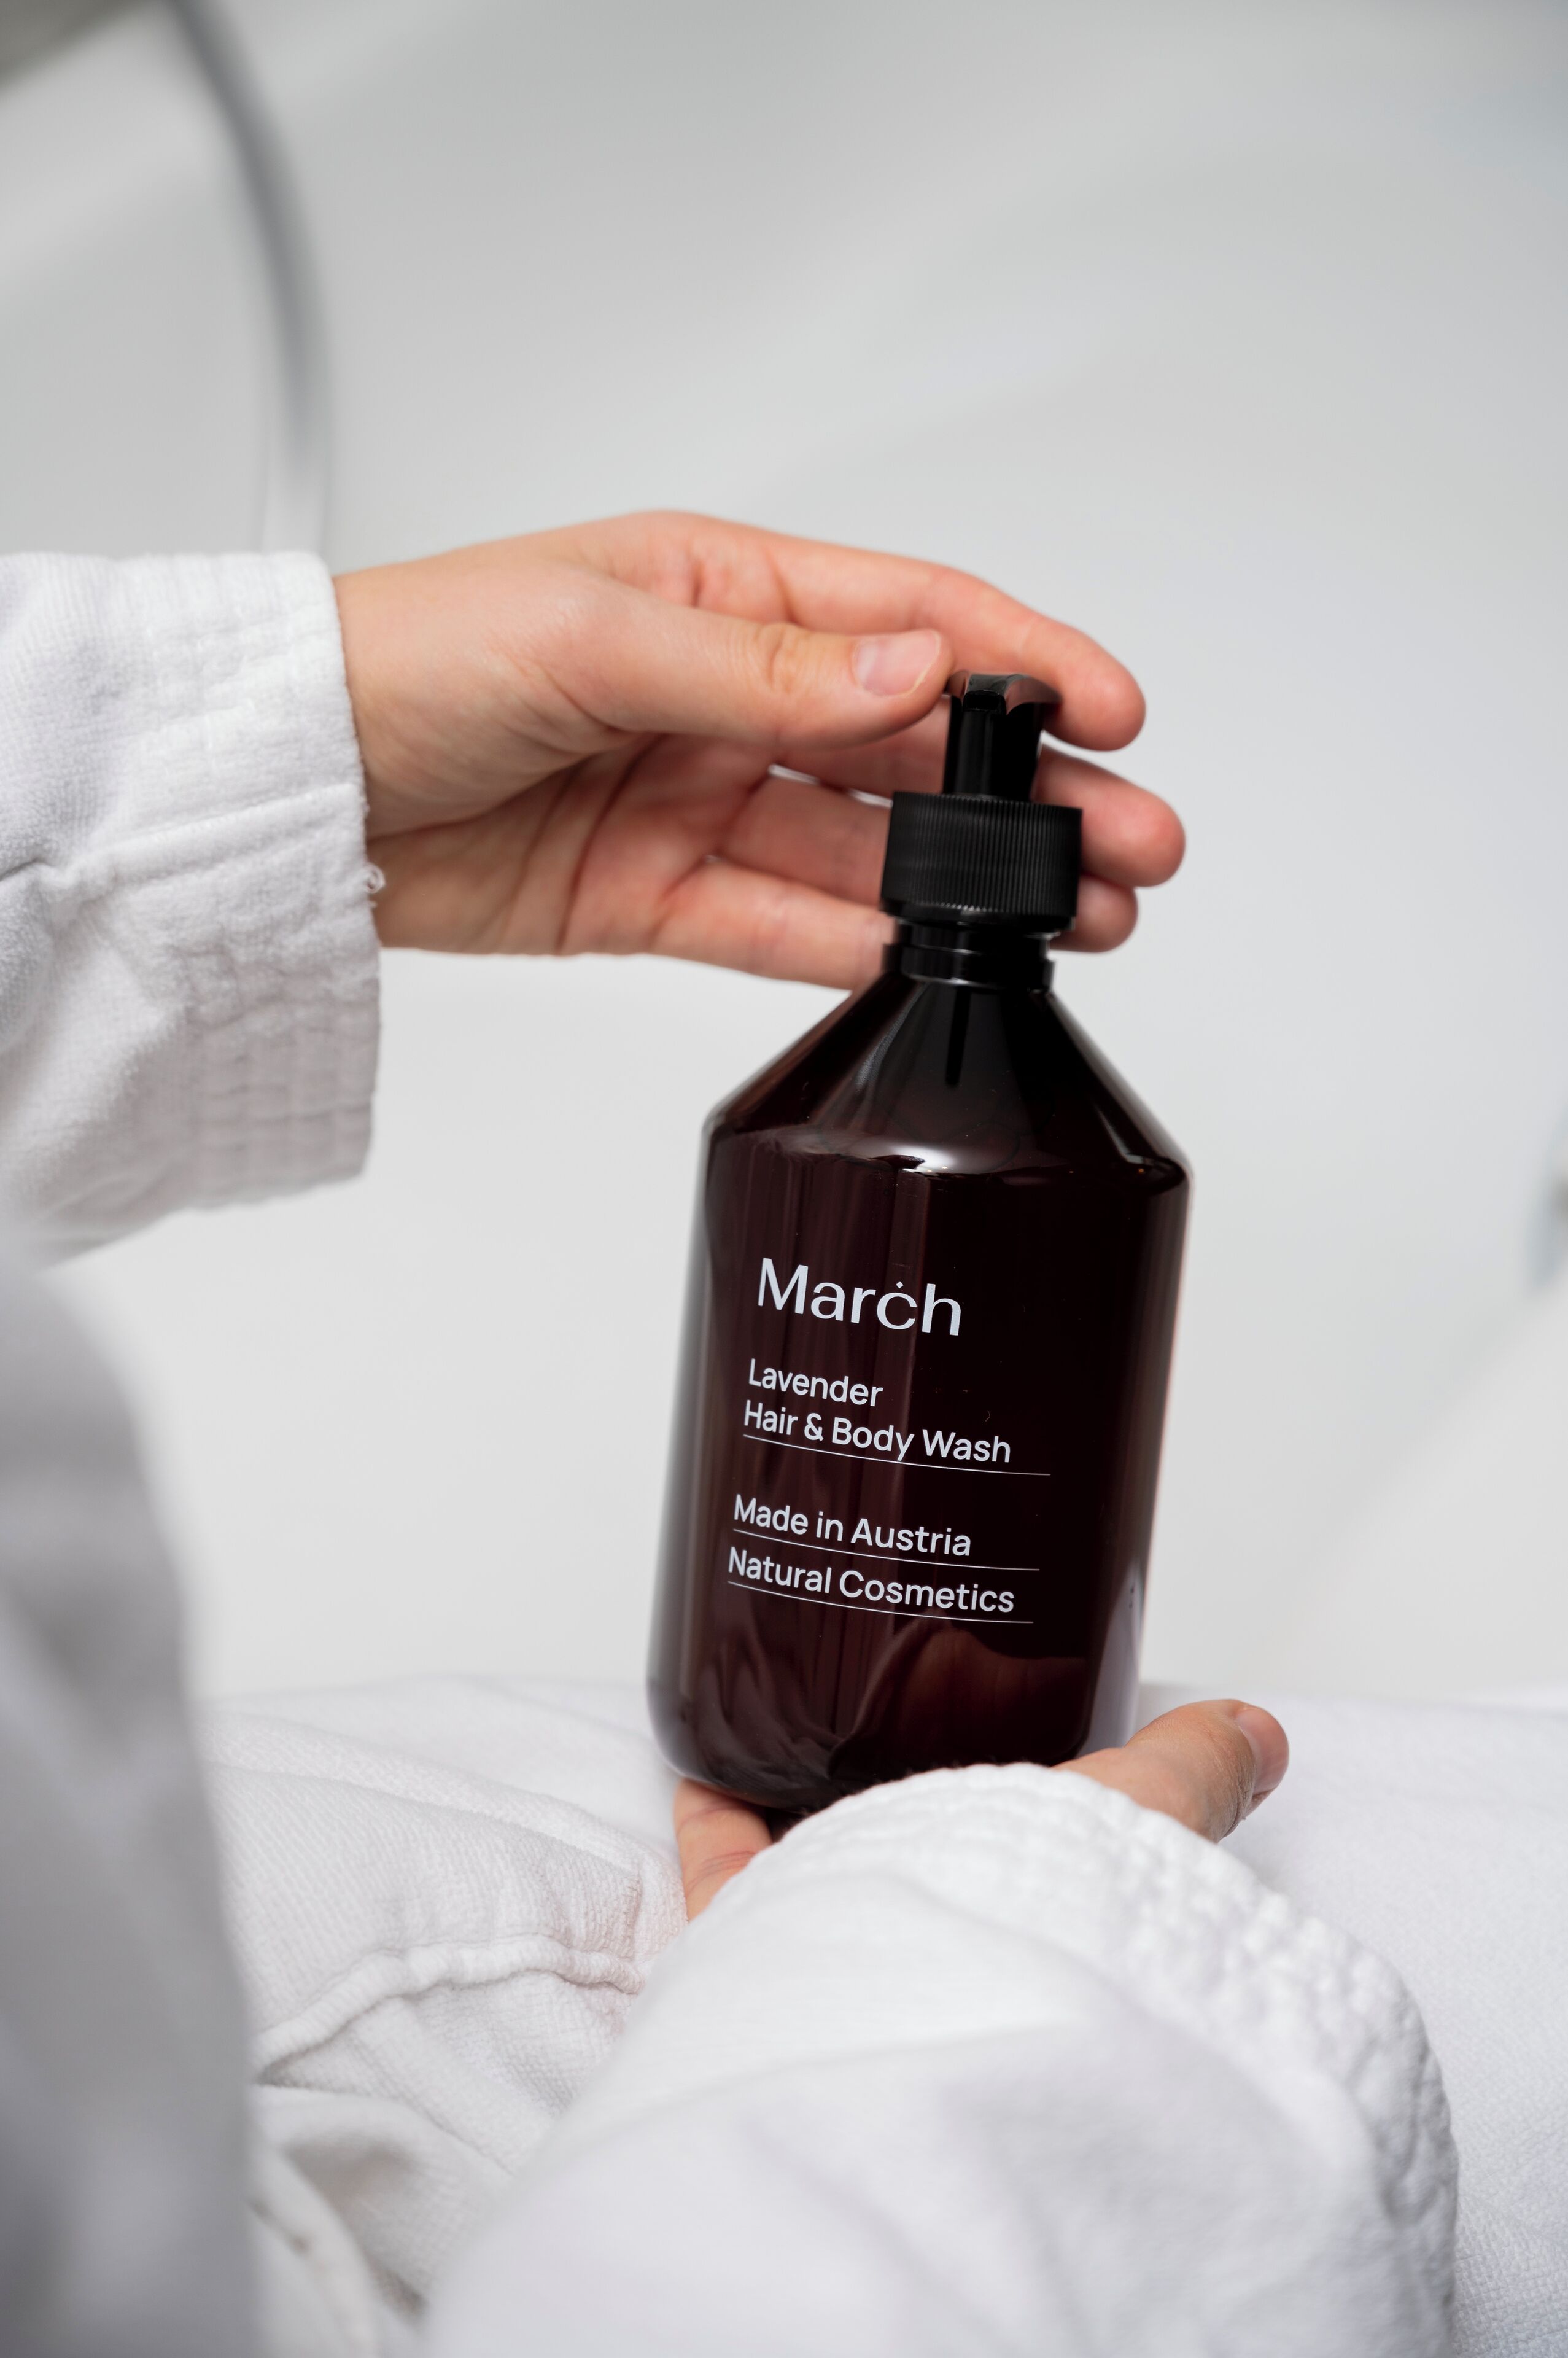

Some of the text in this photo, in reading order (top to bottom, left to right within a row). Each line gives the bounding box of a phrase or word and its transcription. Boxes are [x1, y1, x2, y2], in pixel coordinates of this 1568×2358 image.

[749, 1358, 883, 1407] Lavender
[744, 1399, 1011, 1463] Hair & Body Wash
[734, 1494, 971, 1557] Made in Austria
[728, 1546, 1014, 1613] Natural Cosmetics
